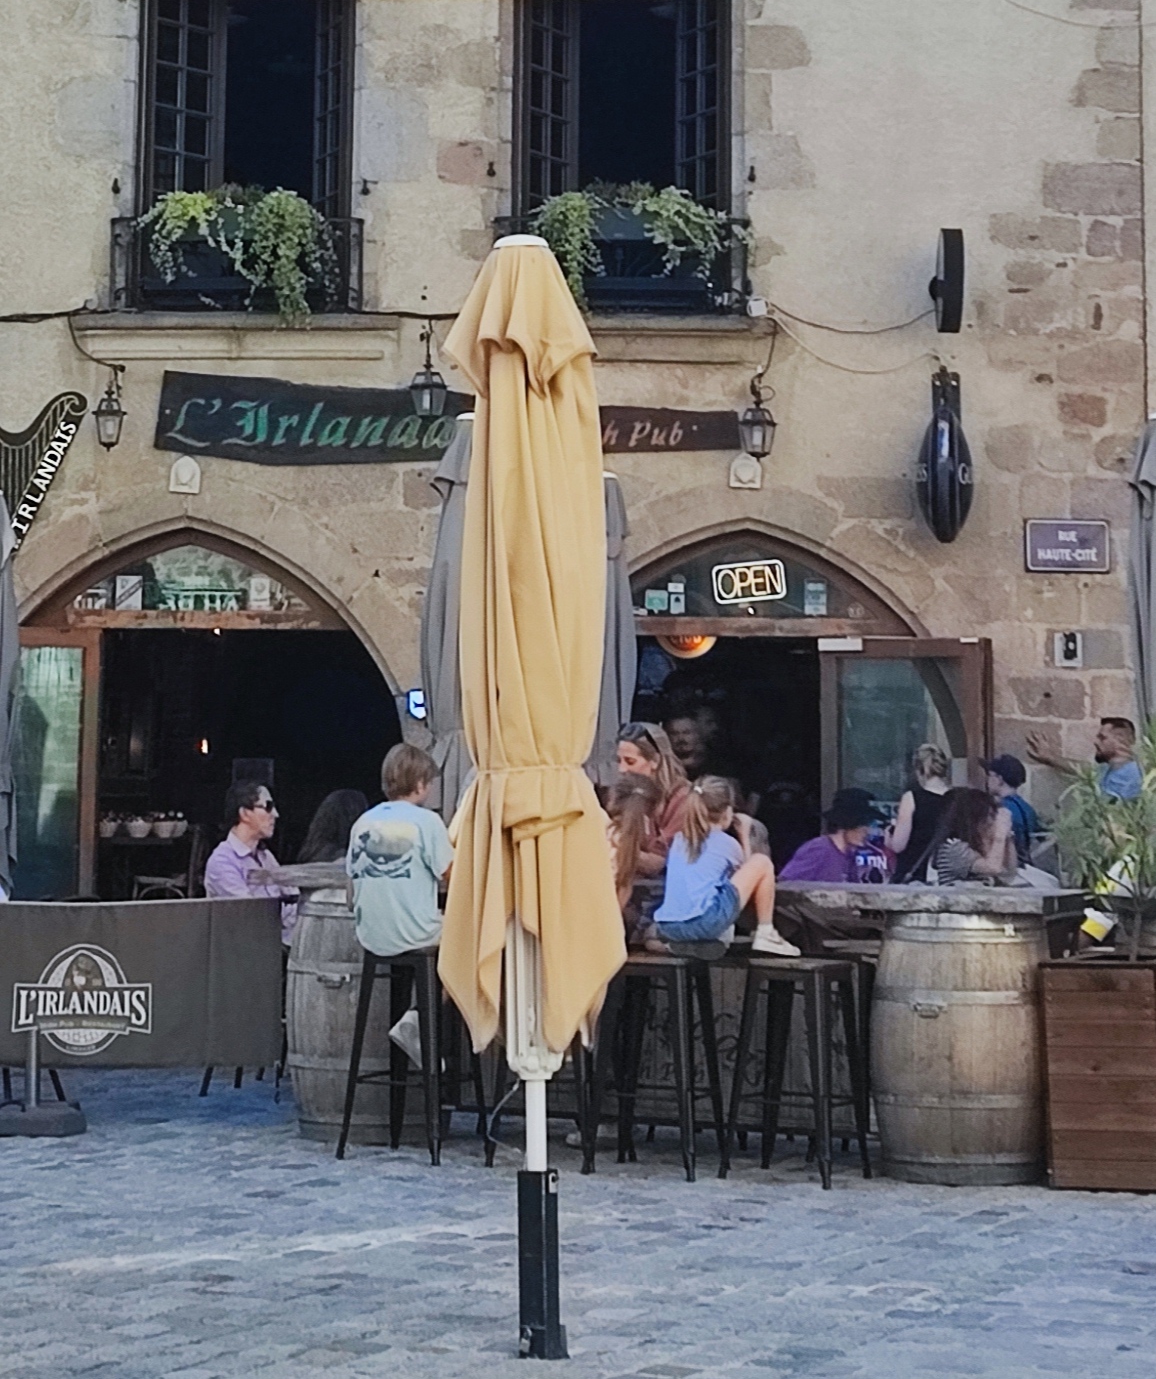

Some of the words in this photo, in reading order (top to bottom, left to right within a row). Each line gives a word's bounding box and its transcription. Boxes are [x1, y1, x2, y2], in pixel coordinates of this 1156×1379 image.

[165, 397, 457, 450] L'Irlanda
[627, 420, 684, 449] Pub
[11, 421, 77, 551] IRLANDAIS
[717, 565, 784, 601] OPEN
[18, 989, 147, 1026] L'IRLANDAIS
